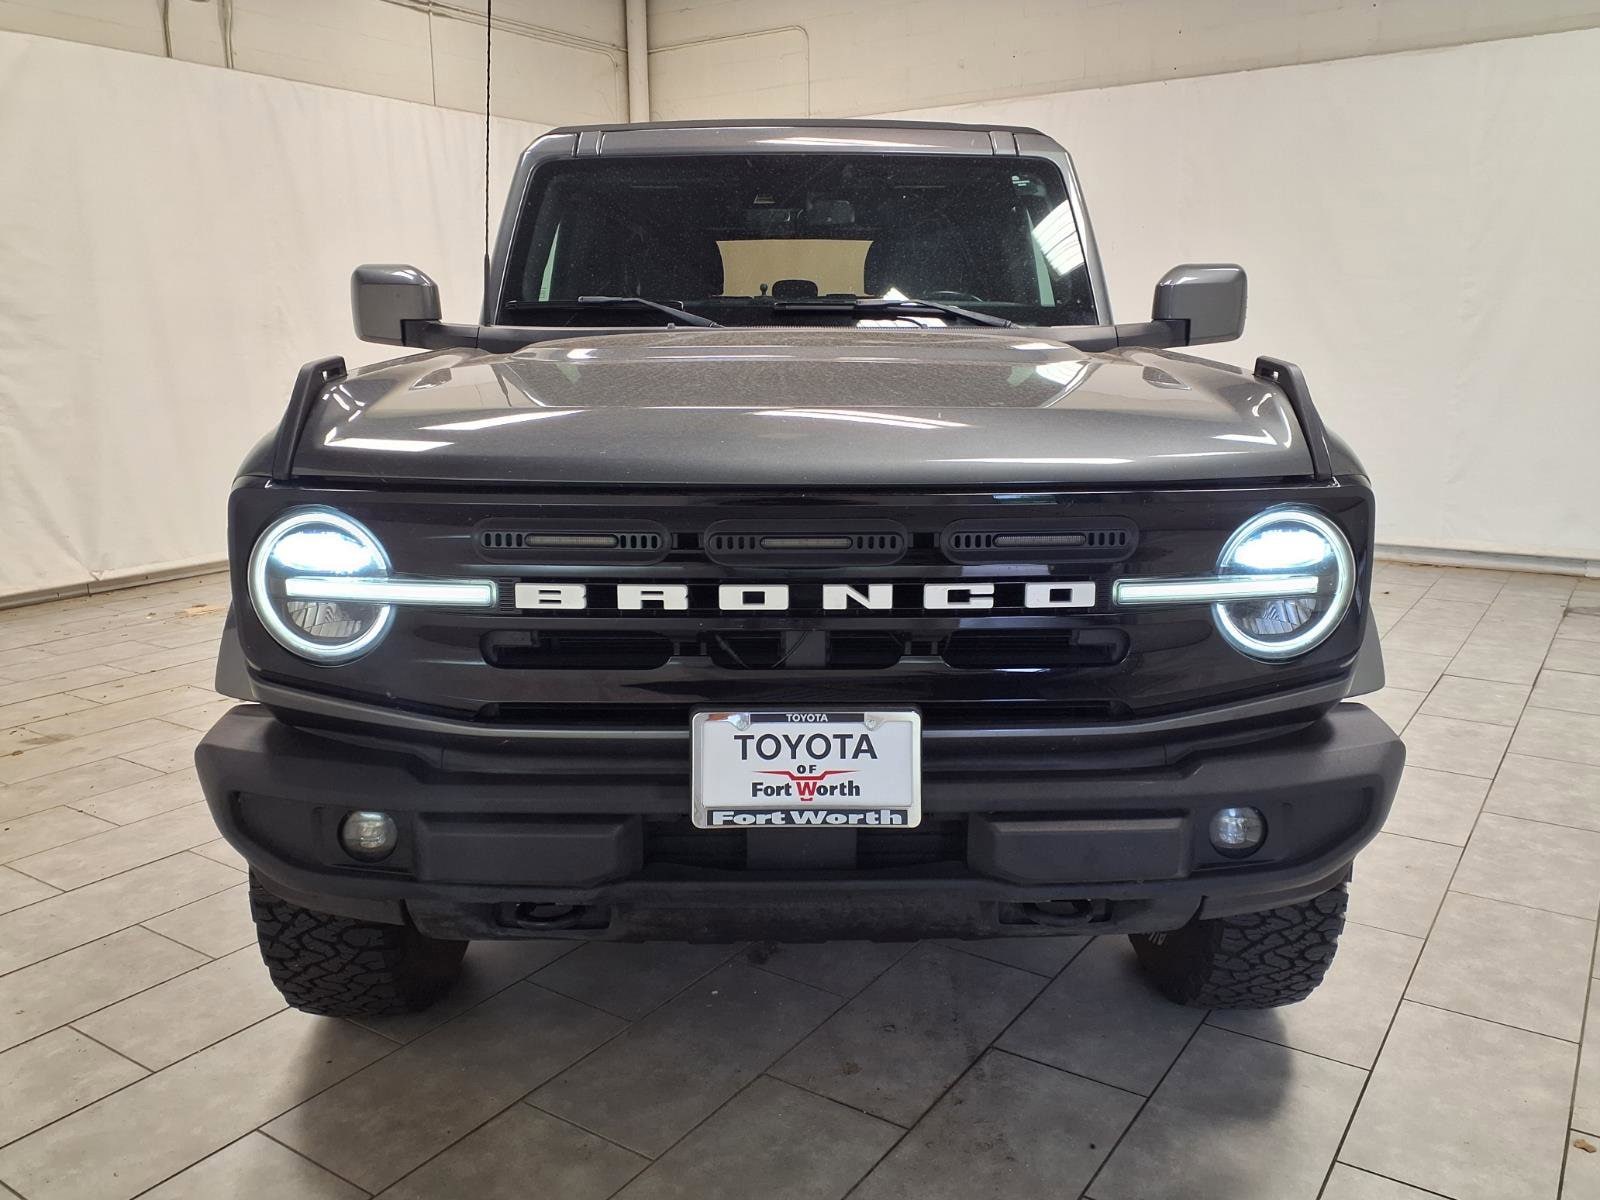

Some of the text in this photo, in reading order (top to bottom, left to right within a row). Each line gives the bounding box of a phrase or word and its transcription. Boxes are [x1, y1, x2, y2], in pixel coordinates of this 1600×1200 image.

[515, 583, 1096, 610] BRONCO
[786, 713, 829, 723] TOYOTA
[734, 733, 878, 760] TOYOTA
[796, 764, 817, 775] OF
[751, 780, 861, 798] Fort Worth
[712, 810, 903, 826] Fort Worth
